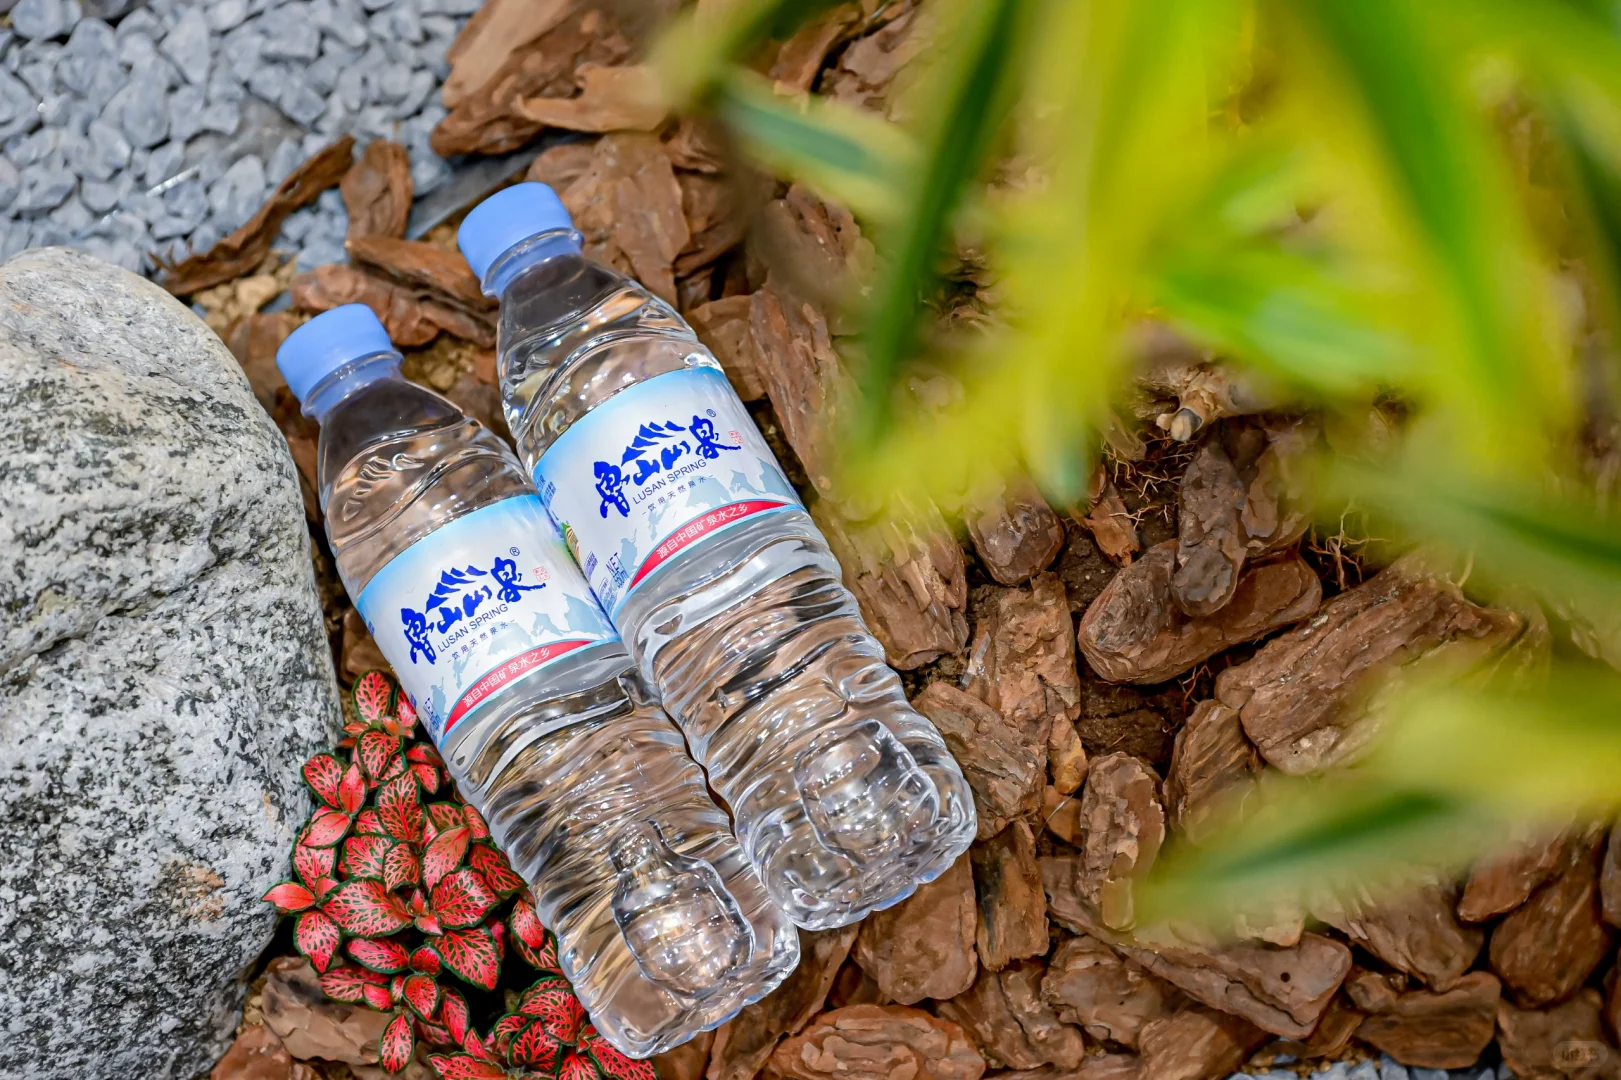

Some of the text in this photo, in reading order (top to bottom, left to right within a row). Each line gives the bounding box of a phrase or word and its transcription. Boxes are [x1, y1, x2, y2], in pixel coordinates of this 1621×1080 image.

[632, 458, 707, 505] LUSAN SPRING
[656, 503, 748, 559] 源自中国矿泉水之乡
[605, 552, 625, 578] NET
[437, 603, 509, 653] LUSAN SPRING
[462, 647, 550, 708] 源自中国矿泉水之乡
